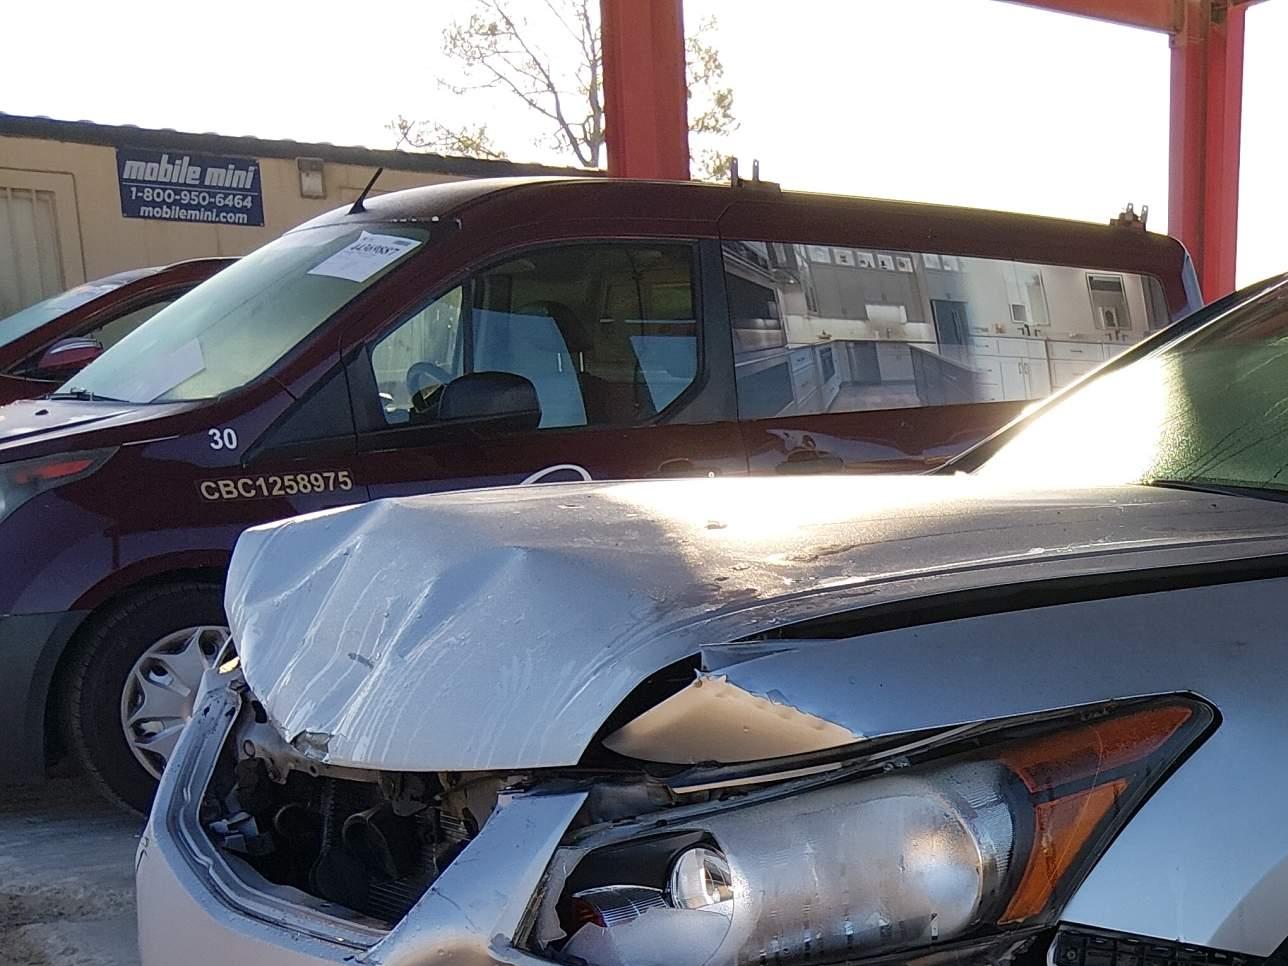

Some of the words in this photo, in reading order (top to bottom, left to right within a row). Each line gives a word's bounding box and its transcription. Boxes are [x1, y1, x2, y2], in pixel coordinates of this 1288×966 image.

[122, 154, 201, 185] mobile
[204, 164, 254, 189] mini
[130, 186, 252, 209] 1-800-950-6464
[140, 205, 248, 224] mobilemini.com
[208, 428, 238, 450] 30
[200, 470, 353, 500] CBC1258975
